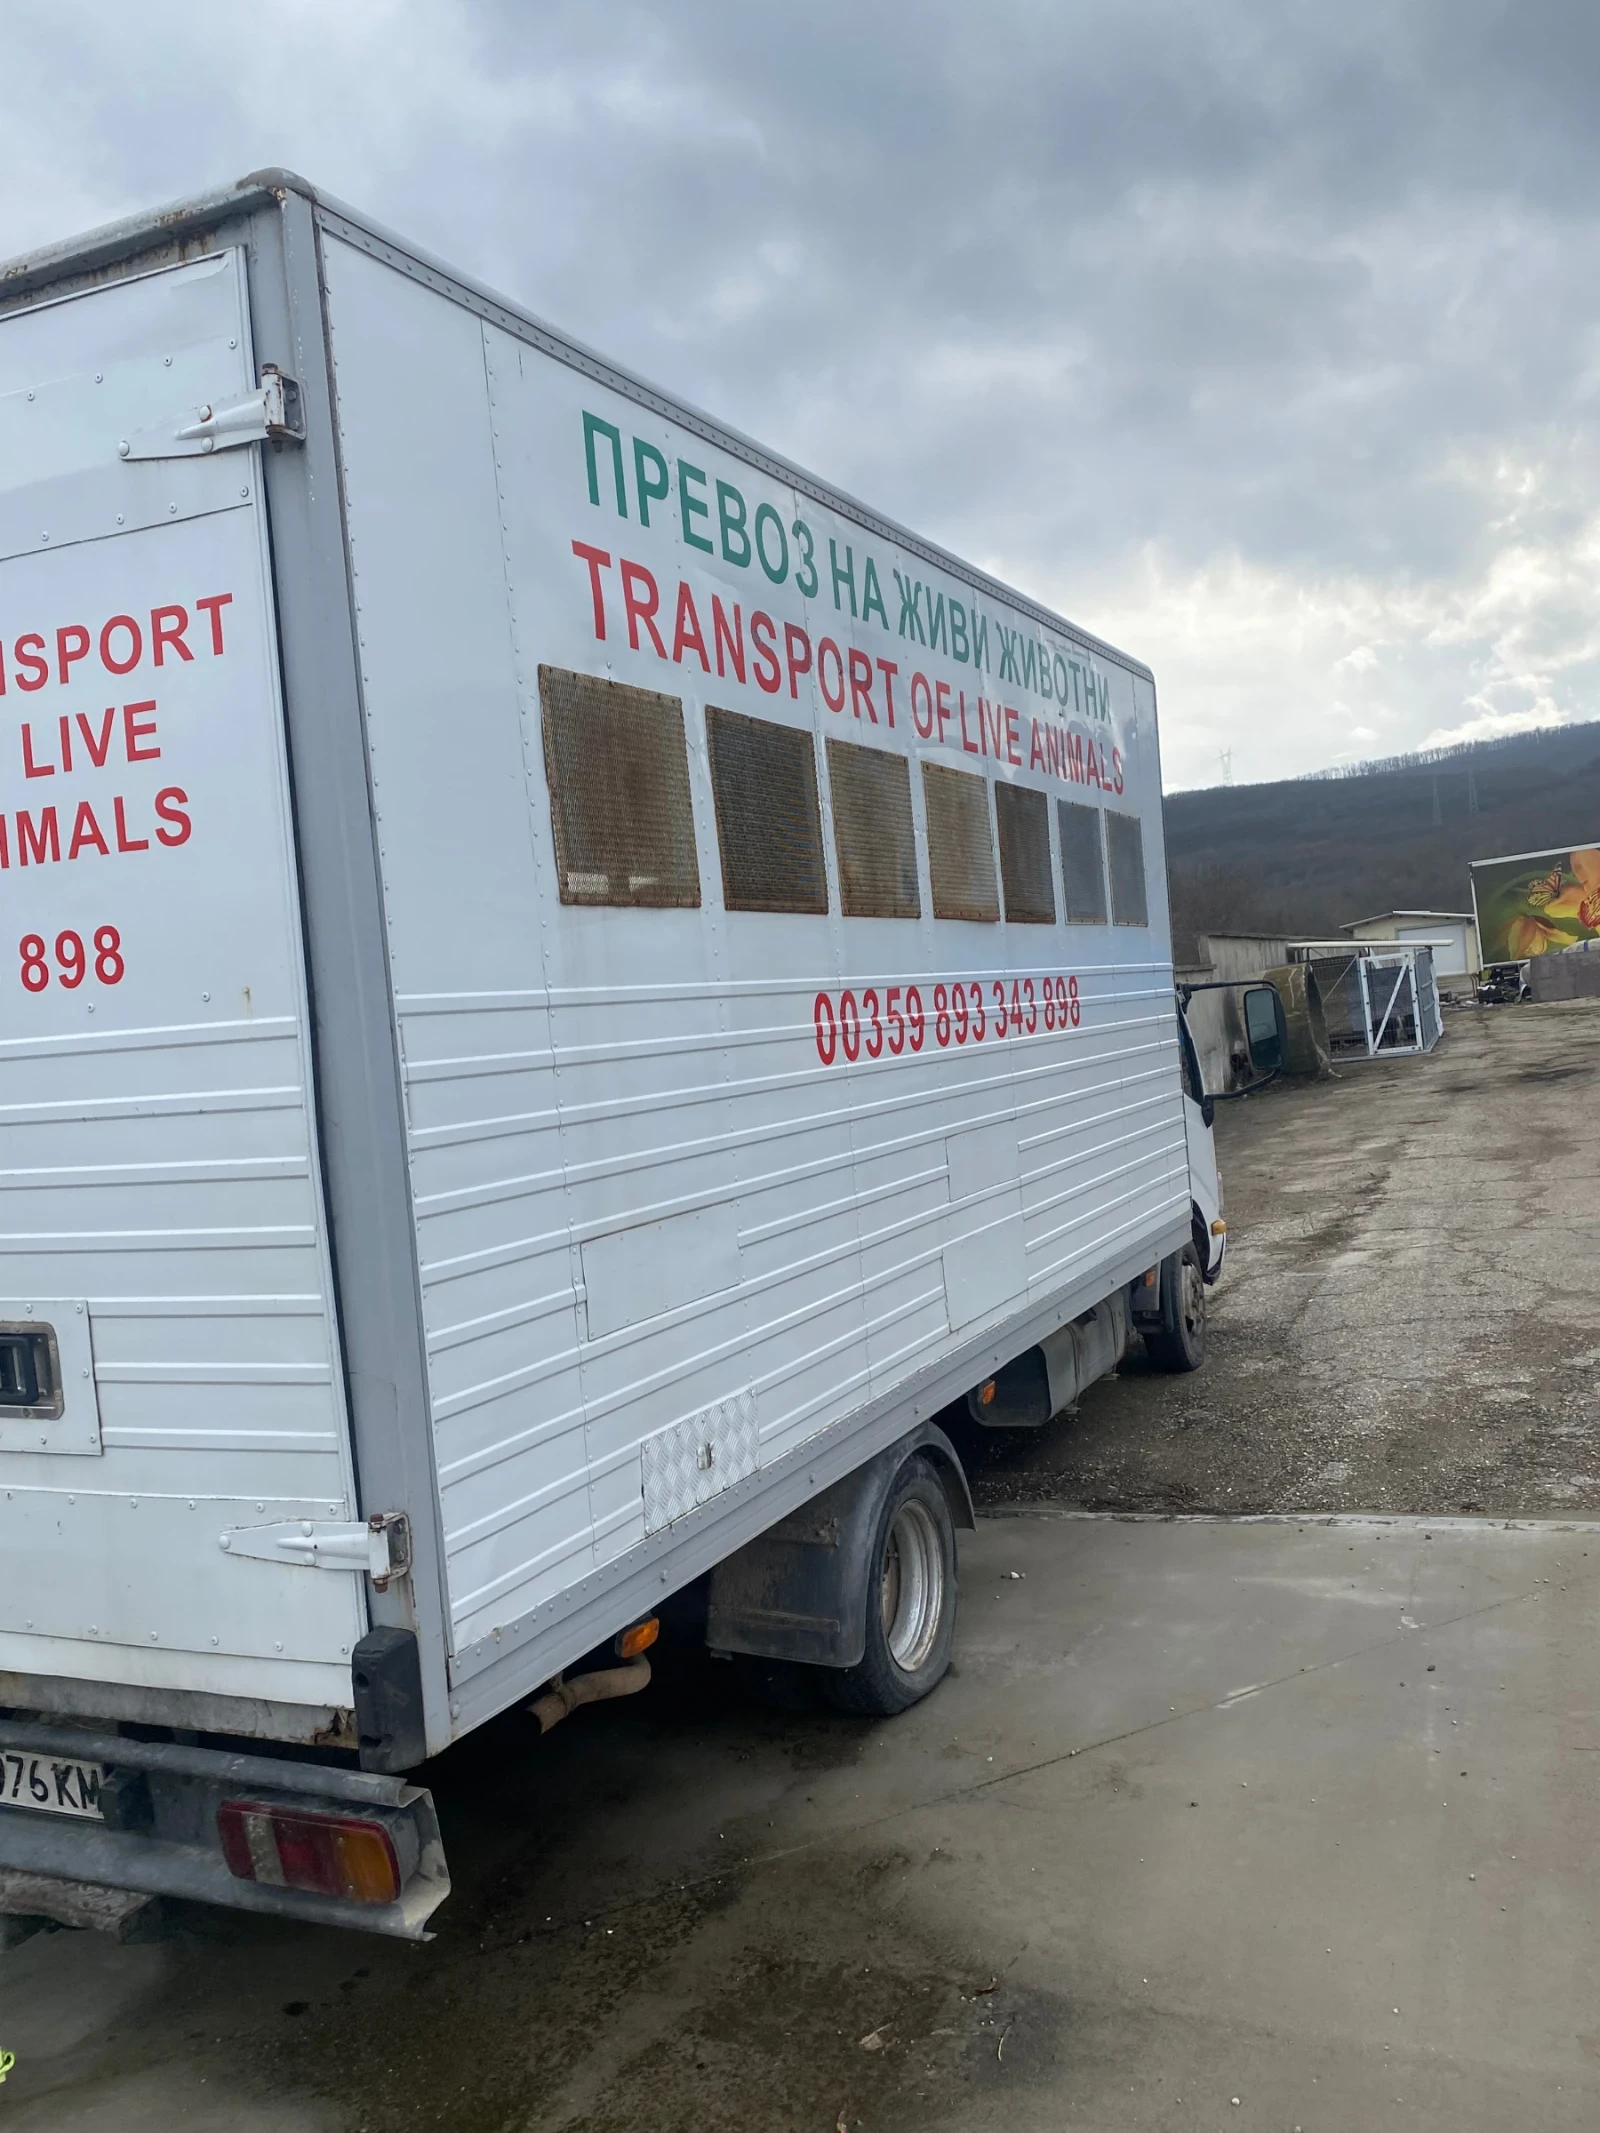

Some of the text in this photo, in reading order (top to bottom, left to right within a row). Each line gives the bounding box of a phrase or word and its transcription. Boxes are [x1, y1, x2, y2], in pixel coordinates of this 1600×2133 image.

[582, 409, 1112, 725] ПРЕВОЗ НА ЖИВИ ЖИВОТНИ
[0, 592, 234, 696] SPORT
[571, 539, 1125, 796] TRANSPORT OF LIVE ANIMALS
[20, 699, 161, 779] LIVE
[19, 925, 126, 993] 898
[813, 975, 1081, 1066] 00359 893 343 898
